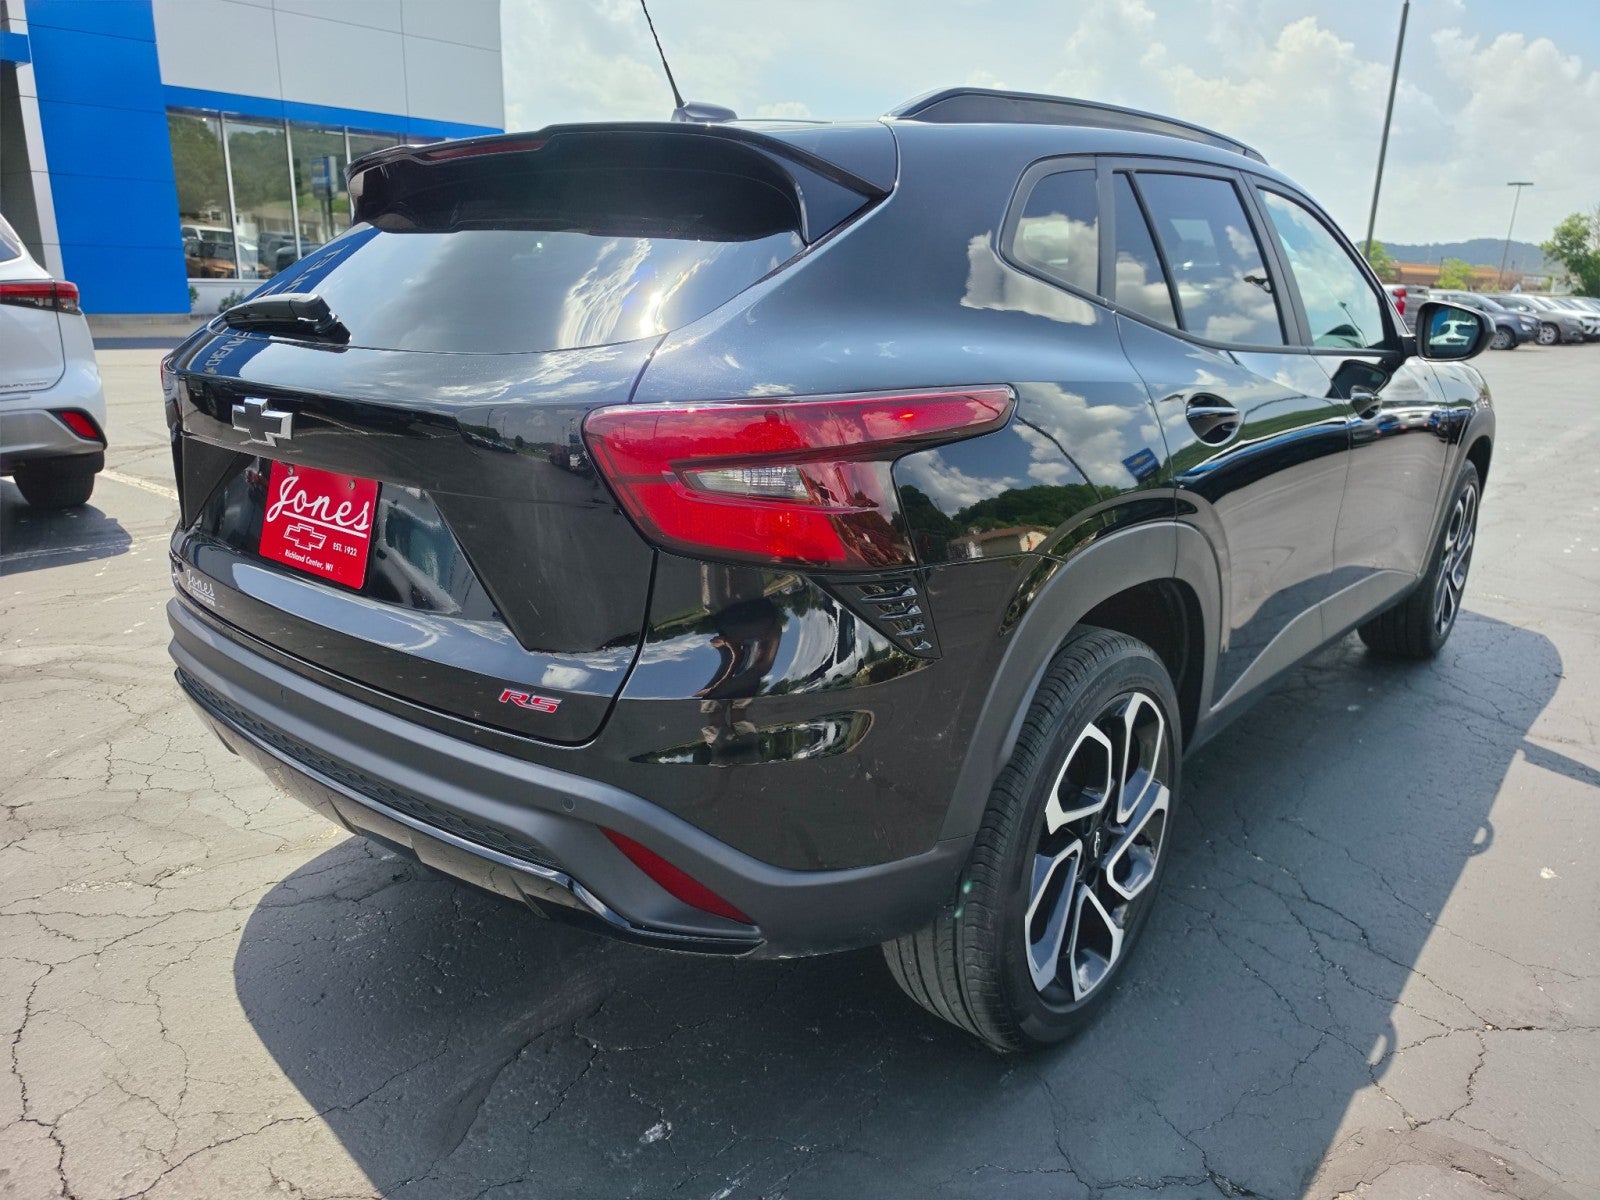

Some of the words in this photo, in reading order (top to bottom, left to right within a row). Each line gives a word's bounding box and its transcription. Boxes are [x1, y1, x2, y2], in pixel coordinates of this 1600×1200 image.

[266, 475, 370, 531] Jones
[284, 549, 305, 563] Richland
[305, 556, 325, 571] Center,
[325, 562, 334, 572] WI
[344, 545, 358, 557] 1922
[498, 688, 562, 714] RS
